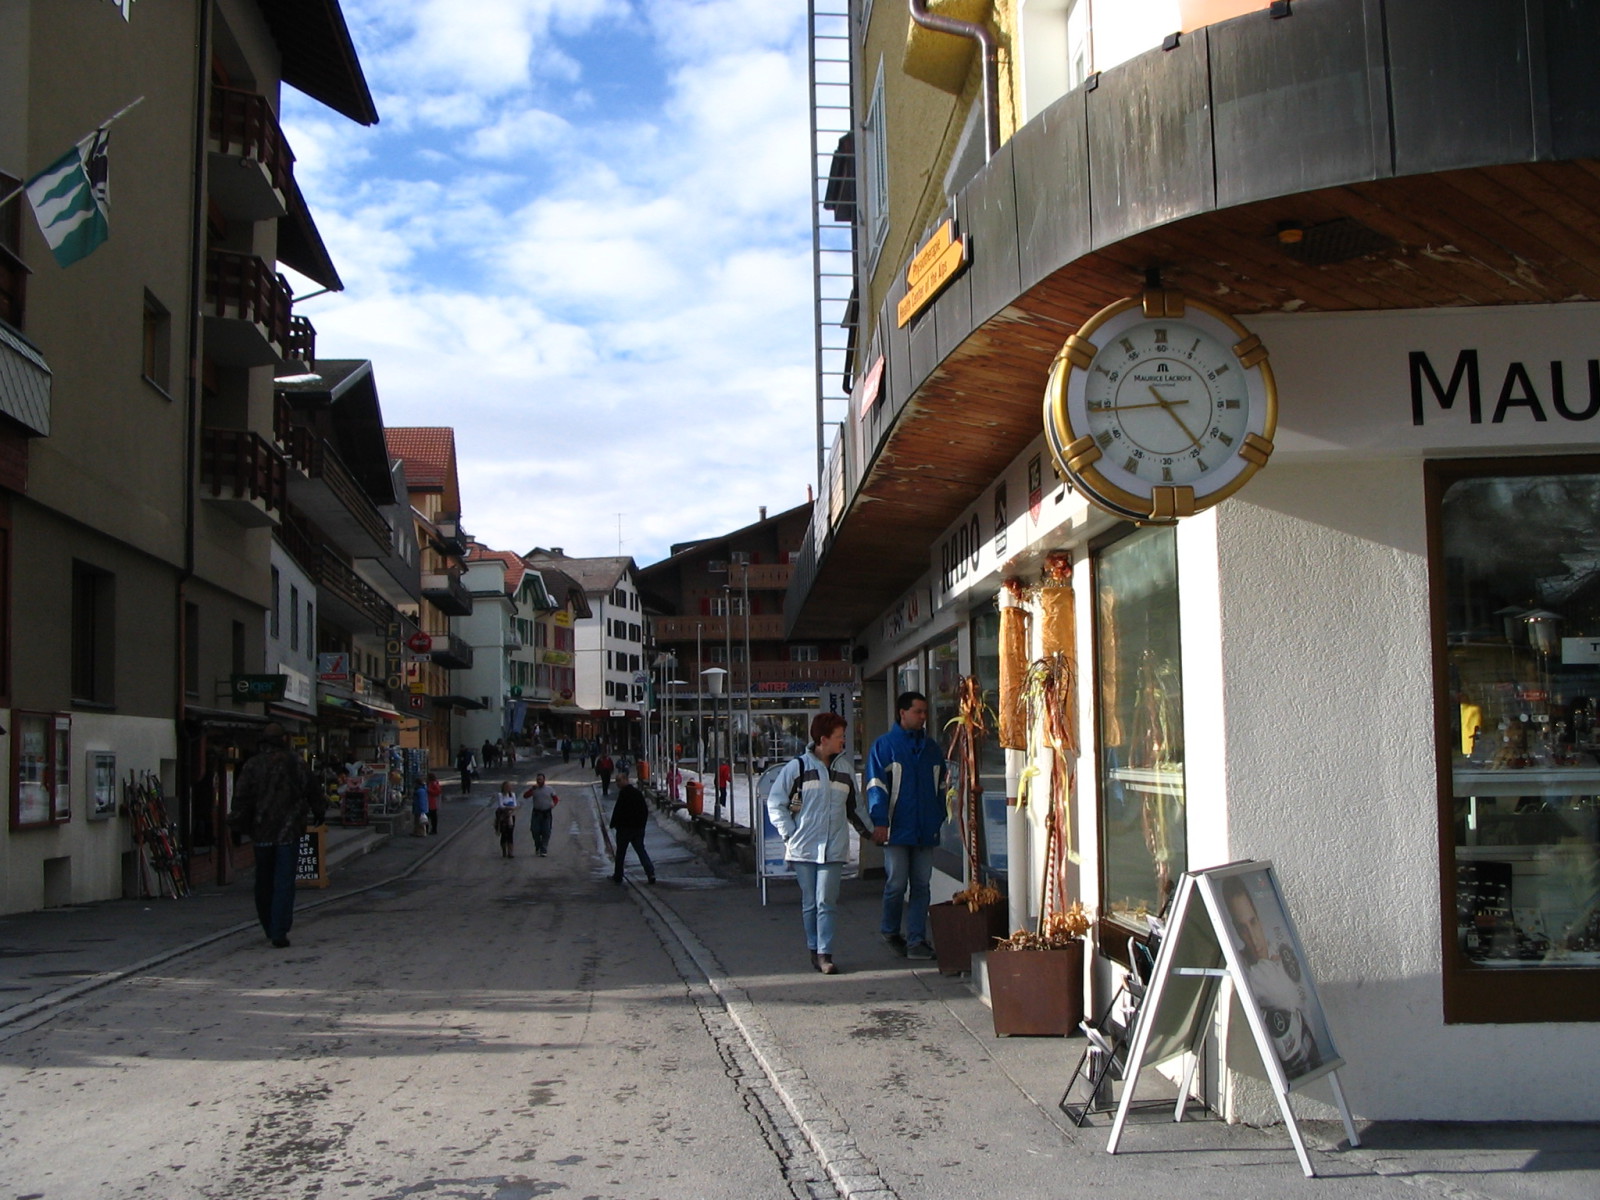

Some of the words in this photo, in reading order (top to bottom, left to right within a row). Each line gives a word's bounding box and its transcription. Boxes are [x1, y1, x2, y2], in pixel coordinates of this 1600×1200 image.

[1157, 345, 1167, 353] 60
[1408, 349, 1600, 426] MAU
[1162, 457, 1172, 466] 30
[941, 513, 980, 595] RADO
[387, 623, 400, 690] FOTO
